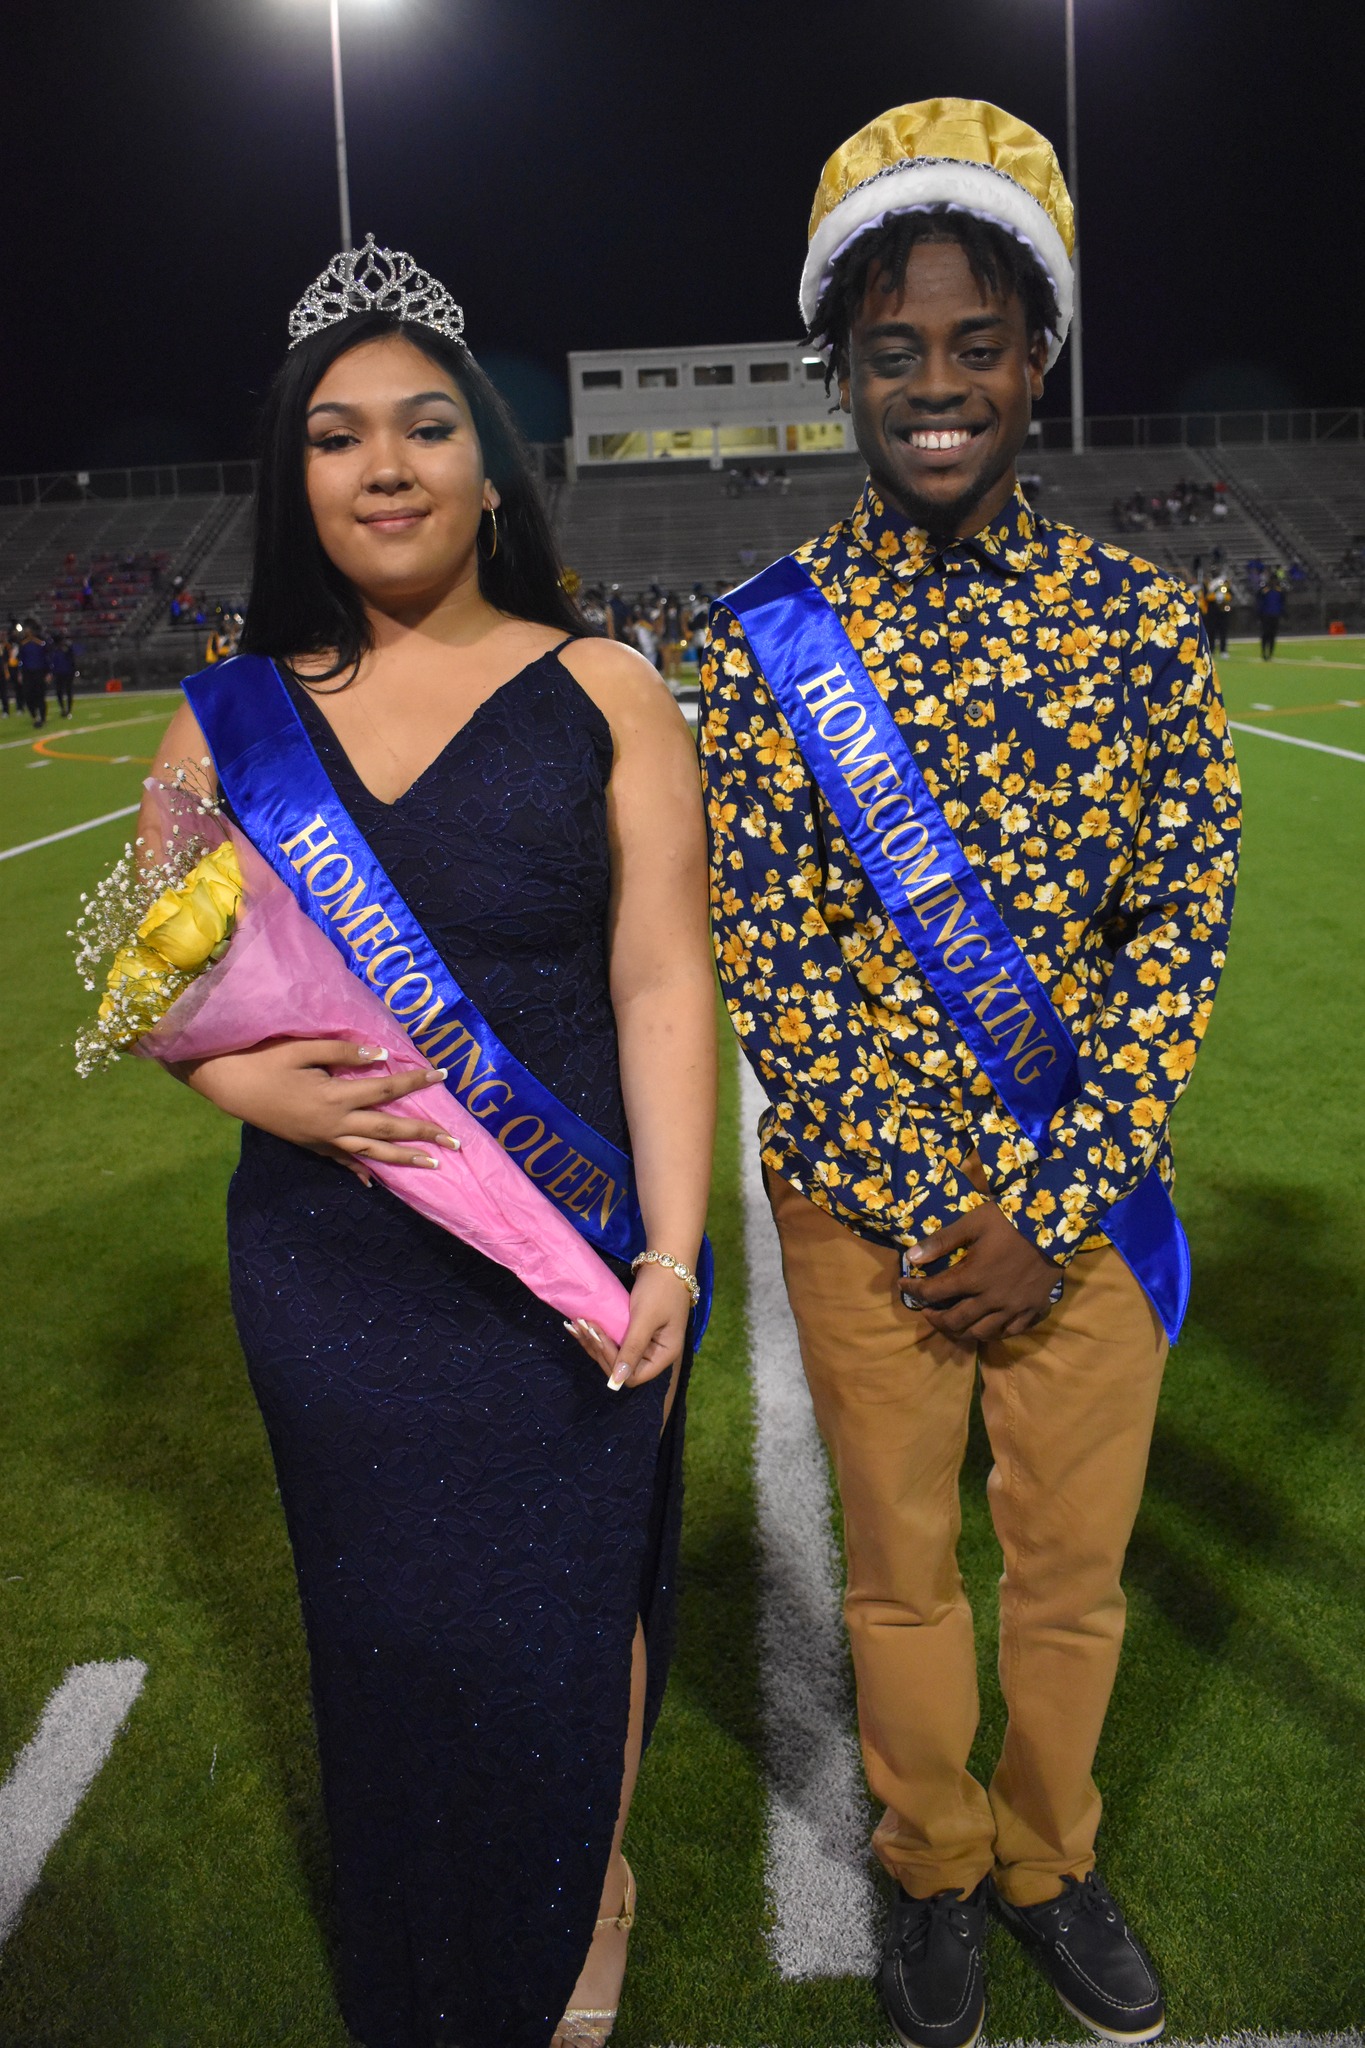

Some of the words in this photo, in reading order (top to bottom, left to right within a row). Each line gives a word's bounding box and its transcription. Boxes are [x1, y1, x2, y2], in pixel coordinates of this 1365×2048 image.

[278, 814, 515, 1119] HOMECOMING
[497, 1115, 627, 1230] QUEEN
[797, 662, 993, 973] HOMECOMING
[963, 967, 1058, 1085] KING
